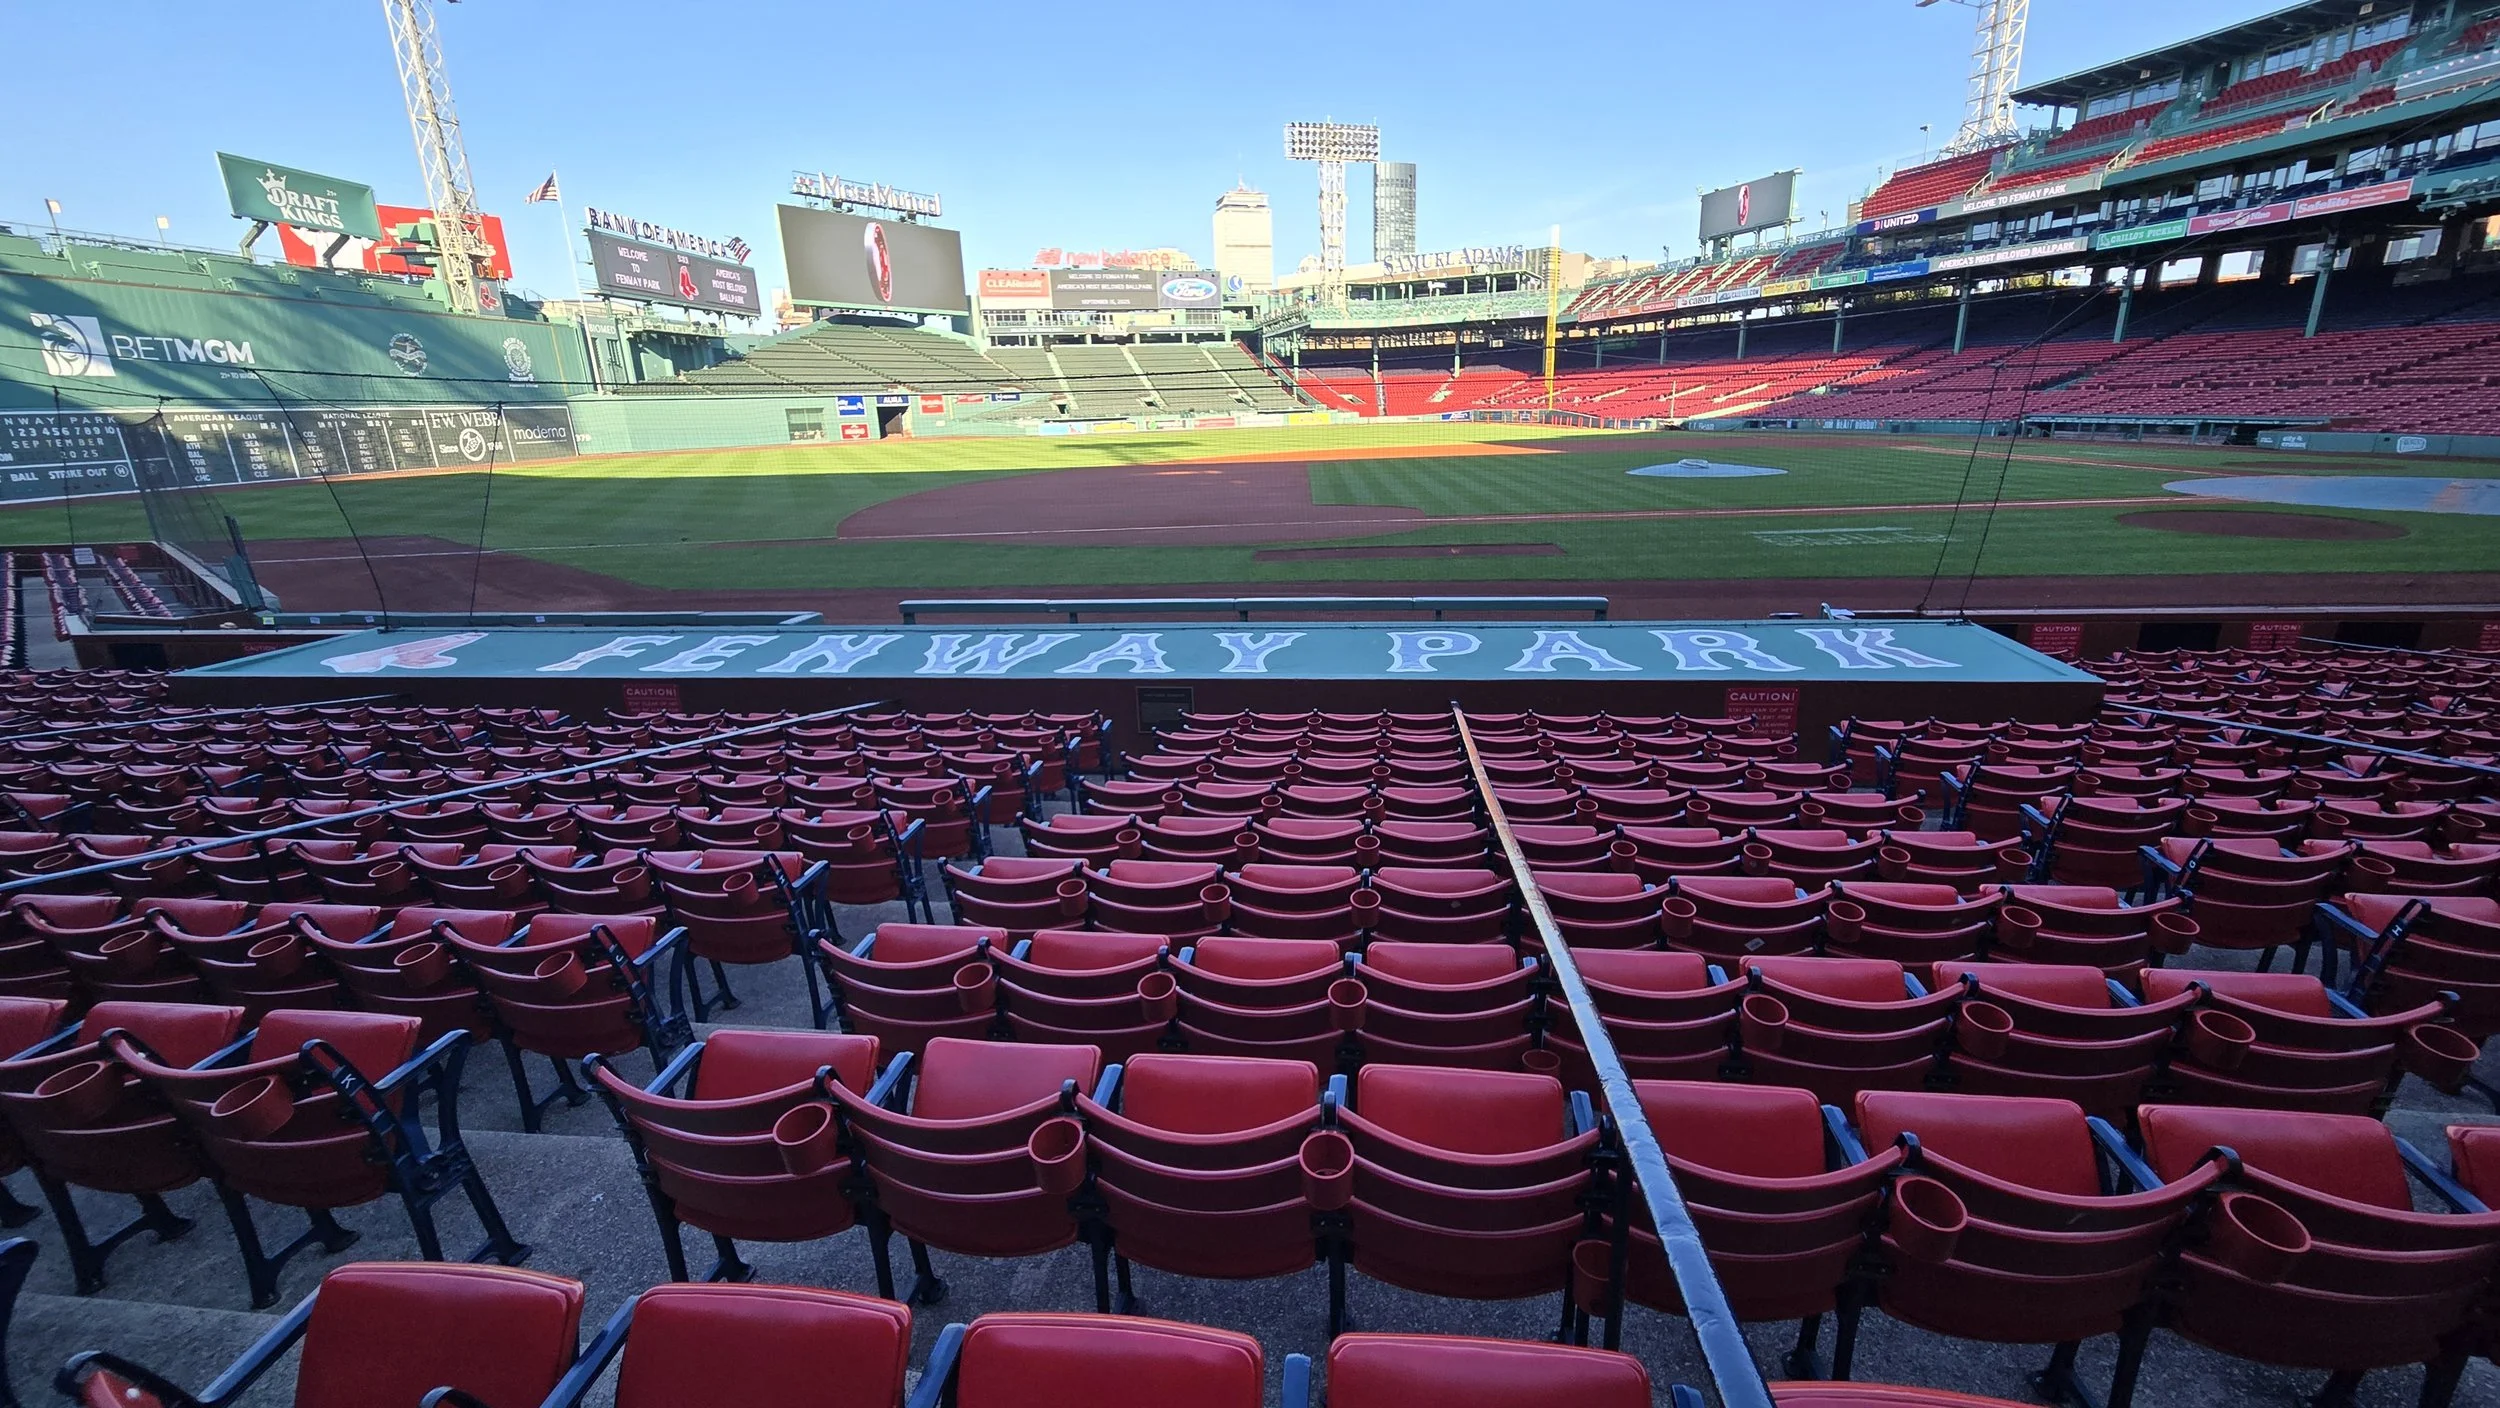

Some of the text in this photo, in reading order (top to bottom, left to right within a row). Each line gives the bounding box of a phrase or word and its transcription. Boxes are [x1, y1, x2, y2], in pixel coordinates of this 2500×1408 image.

[267, 187, 339, 213] DRAFT
[818, 172, 941, 216] MassMutual
[1963, 183, 2066, 212] WELCOME TO FENWAY PARK
[2298, 197, 2350, 213] Safelite
[281, 206, 345, 229] KINGS
[1884, 213, 1919, 229] UNITED
[585, 207, 727, 257] BANK OF AMERICA
[2110, 225, 2183, 244] GRILLO'S PICKLES
[617, 246, 648, 262] WELCOME
[1067, 249, 1171, 267] new balance
[1384, 245, 1524, 275] SAMUEL ADAMS
[1938, 242, 2075, 269] AMERICA'S MOST BELOVED BALLPARK
[631, 263, 641, 273] TO
[615, 273, 661, 290] FENWAY PARK
[712, 279, 748, 294] MOST BELOVED
[1173, 282, 1208, 298] Ford
[719, 292, 745, 305] BALLPARK
[111, 334, 256, 365] BETMGM
[69, 415, 117, 424] PARK
[173, 414, 225, 422] AMERICAN
[322, 412, 360, 420] NATIONAL
[9, 426, 115, 437] 1 2 3 4 5 6 7 8 9 10
[513, 425, 566, 440] moderna
[190, 458, 207, 466] TOR
[10, 472, 40, 482] BALL
[86, 468, 107, 477] OUT
[254, 470, 269, 478] CLE
[536, 628, 1962, 674] FENWAY PARK
[626, 688, 677, 697] CAUTION!
[1729, 692, 1795, 701] CAUTION!
[2391, 924, 2403, 937] H
[340, 1073, 357, 1090] K
